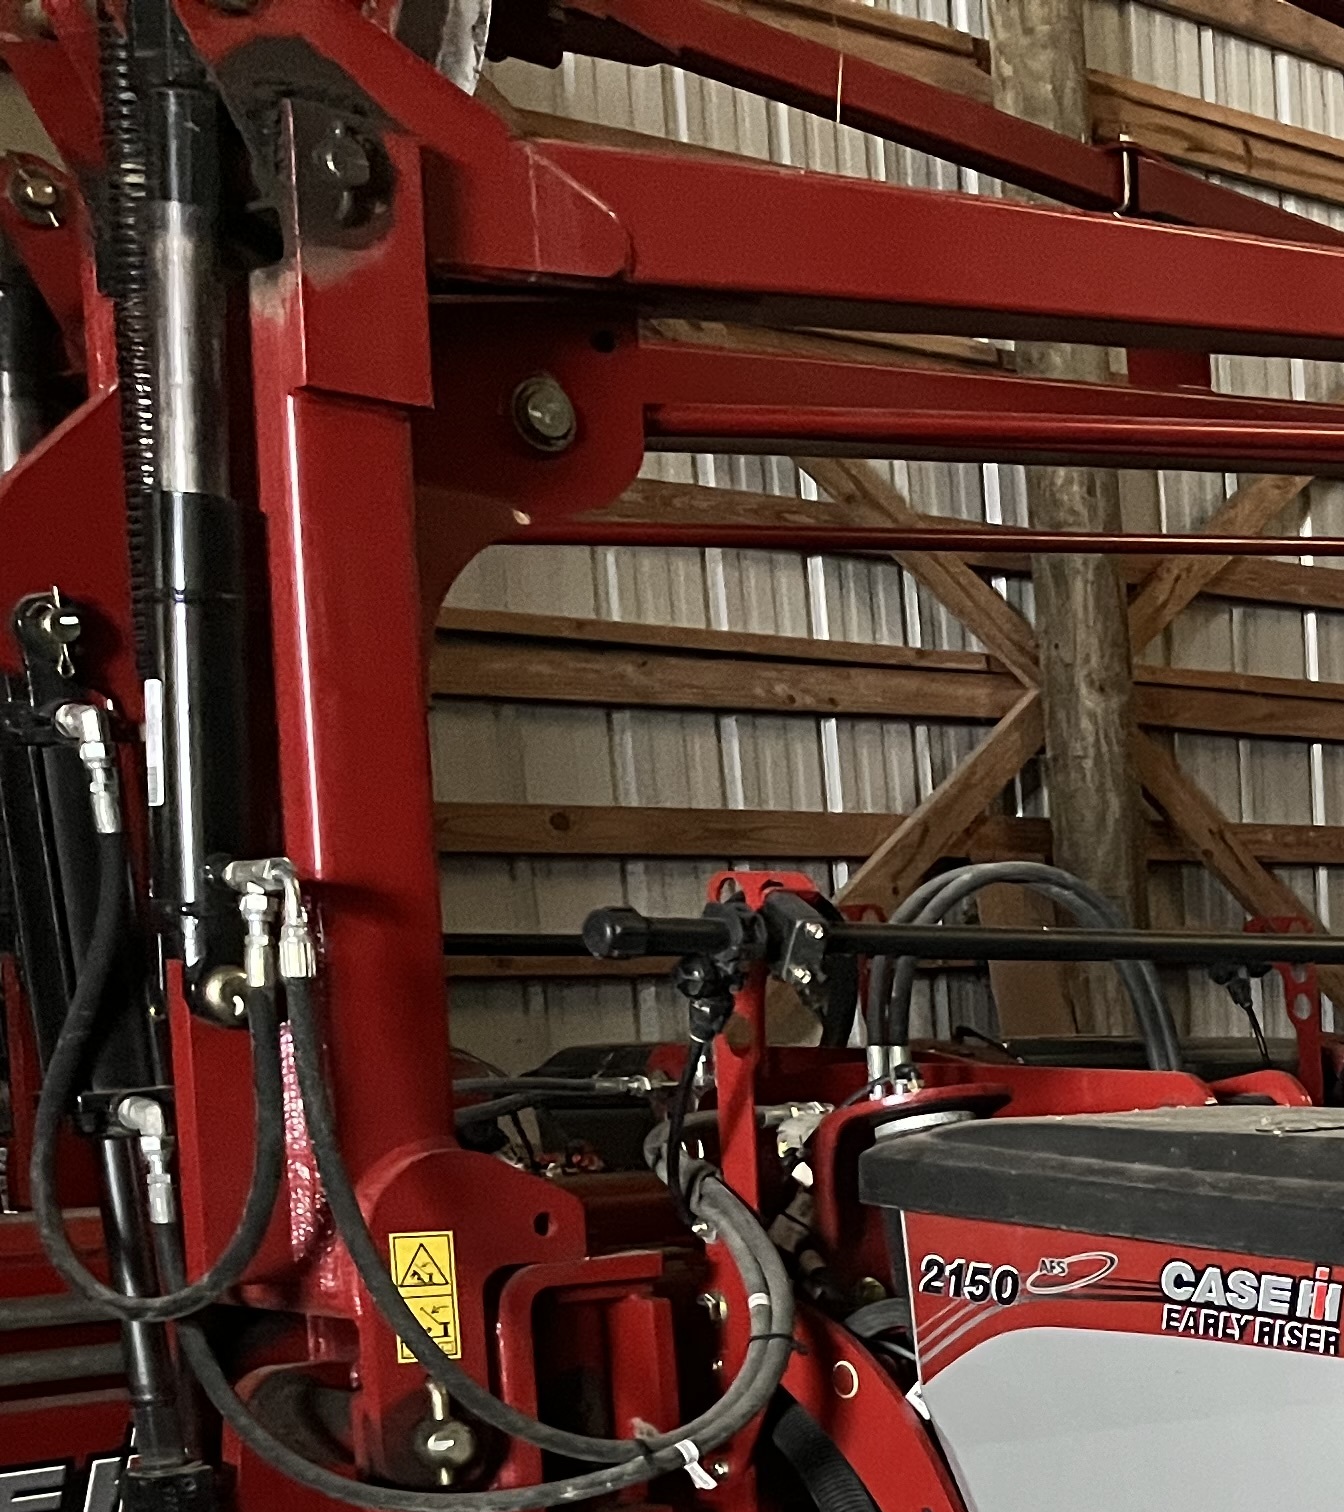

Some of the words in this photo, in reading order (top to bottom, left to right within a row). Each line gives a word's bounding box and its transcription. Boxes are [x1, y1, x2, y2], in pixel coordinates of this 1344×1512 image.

[918, 1253, 1020, 1306] 2150
[1039, 1258, 1067, 1275] AFS
[1160, 1260, 1293, 1316] CASE
[1161, 1303, 1253, 1342] EARLY
[1253, 1315, 1341, 1356] RISER
